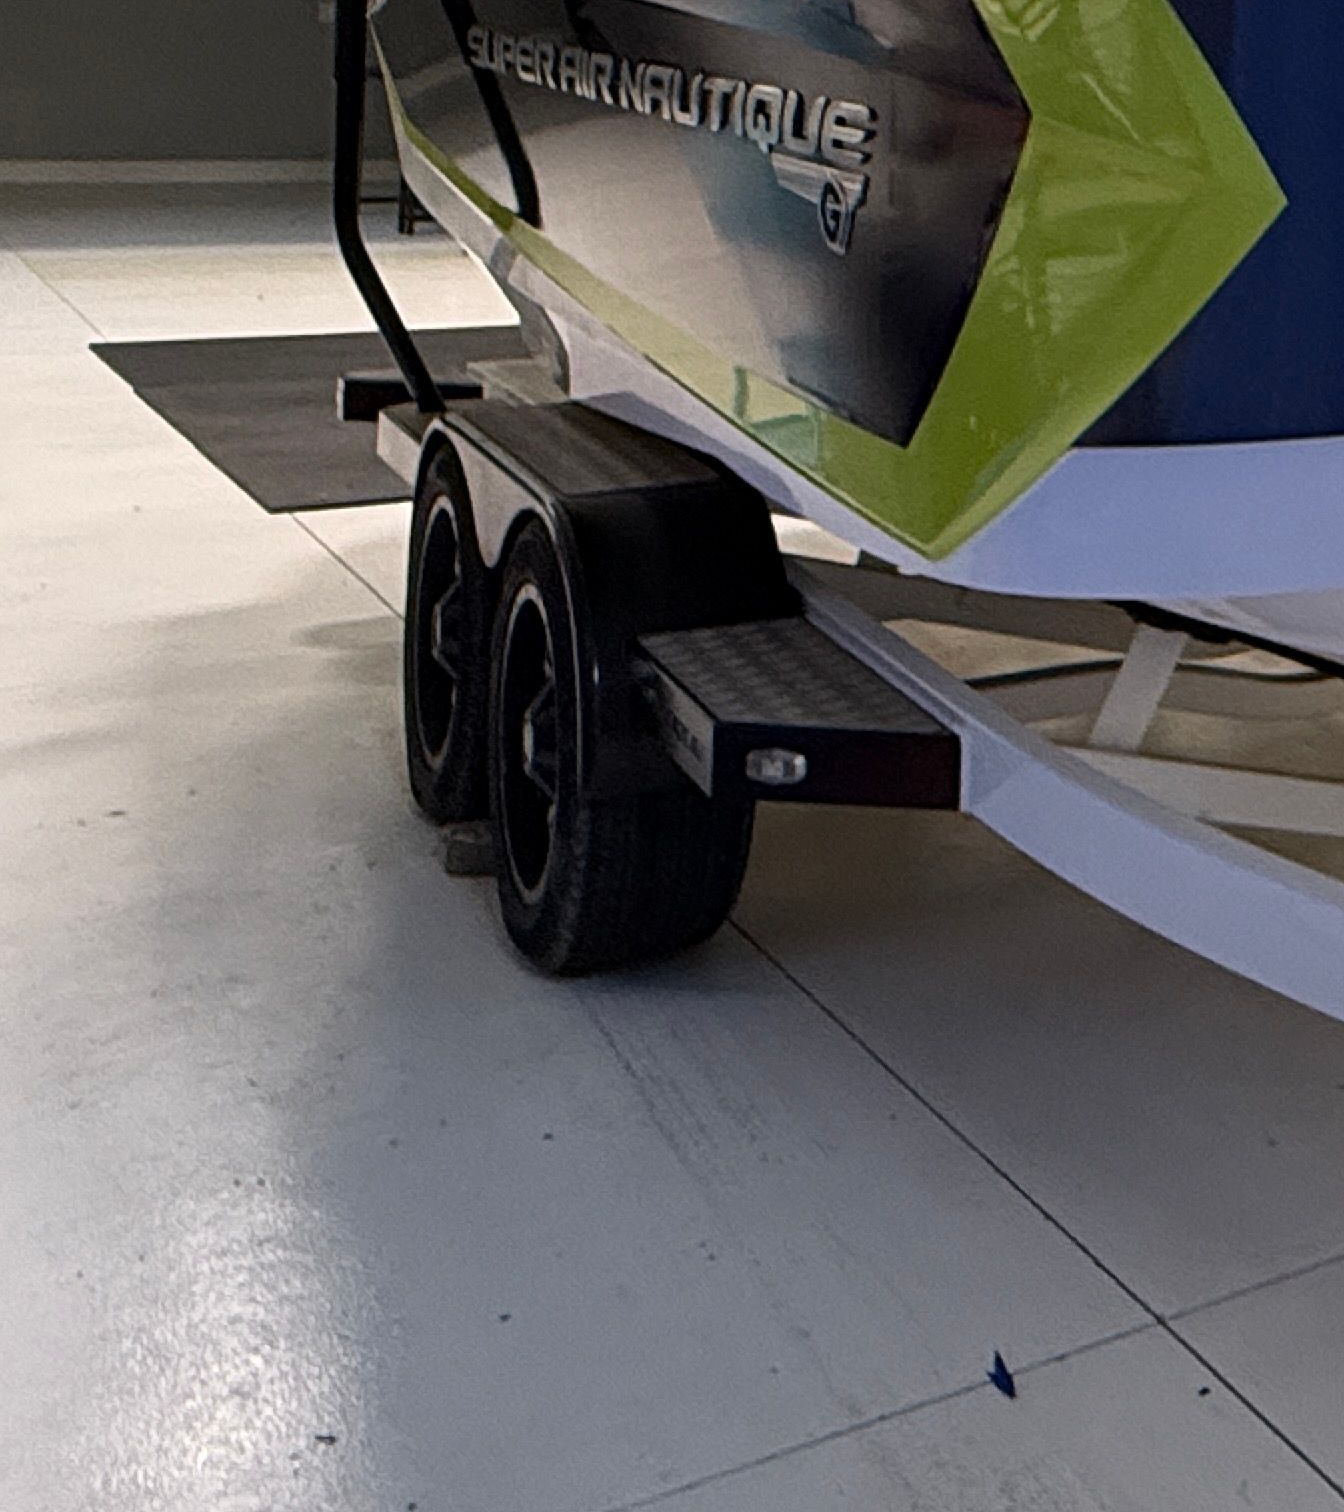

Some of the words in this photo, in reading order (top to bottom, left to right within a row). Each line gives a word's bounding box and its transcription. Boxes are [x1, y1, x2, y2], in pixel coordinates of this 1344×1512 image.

[466, 26, 557, 90] SUPER
[561, 45, 614, 105] AIR
[618, 56, 873, 166] NAUTIQUE
